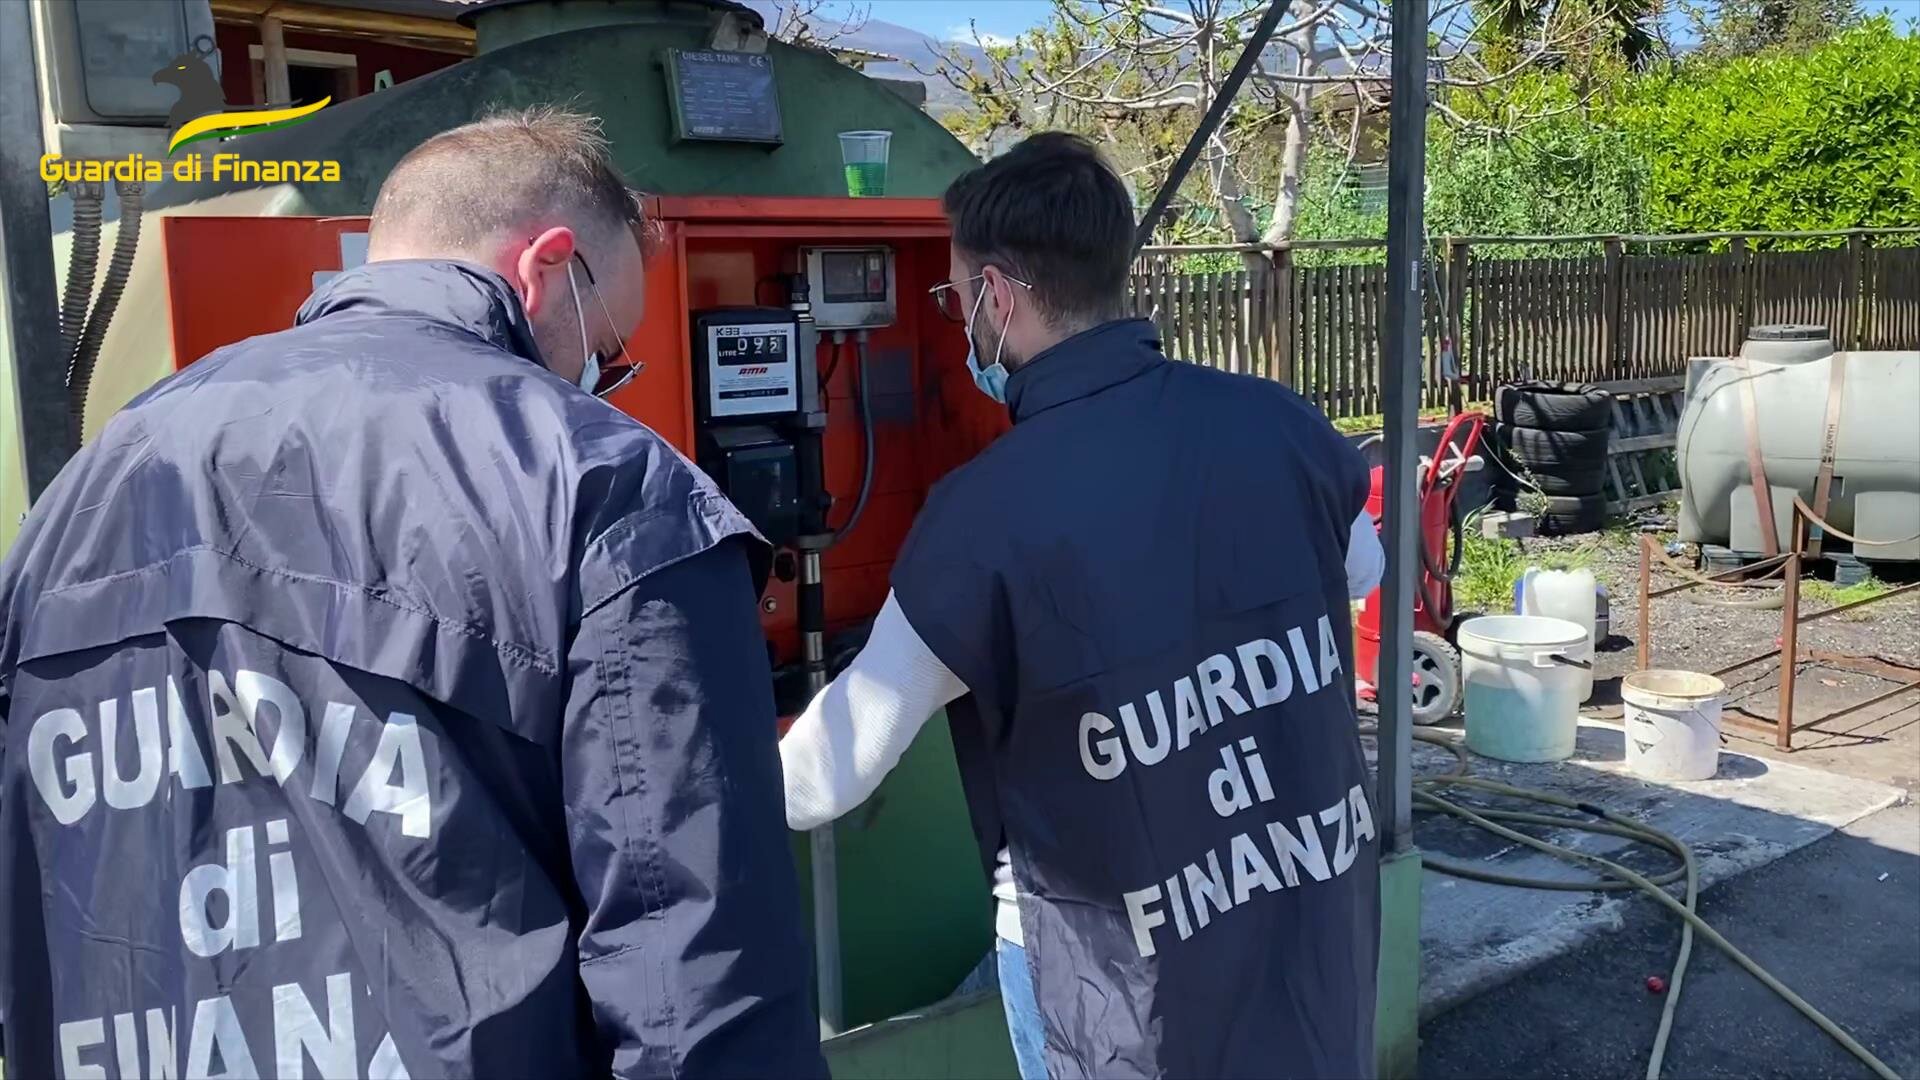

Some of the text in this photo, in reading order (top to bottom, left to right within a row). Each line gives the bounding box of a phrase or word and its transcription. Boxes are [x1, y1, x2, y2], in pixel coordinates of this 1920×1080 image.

[682, 51, 714, 62] DIESEL
[716, 54, 740, 63] TANK
[27, 669, 431, 839] GUARDIA
[1079, 614, 1343, 780] GUARDIA
[1208, 736, 1276, 817] di
[179, 819, 302, 957] di
[1123, 784, 1375, 957] FINANZA
[60, 972, 411, 1080] FINAN
